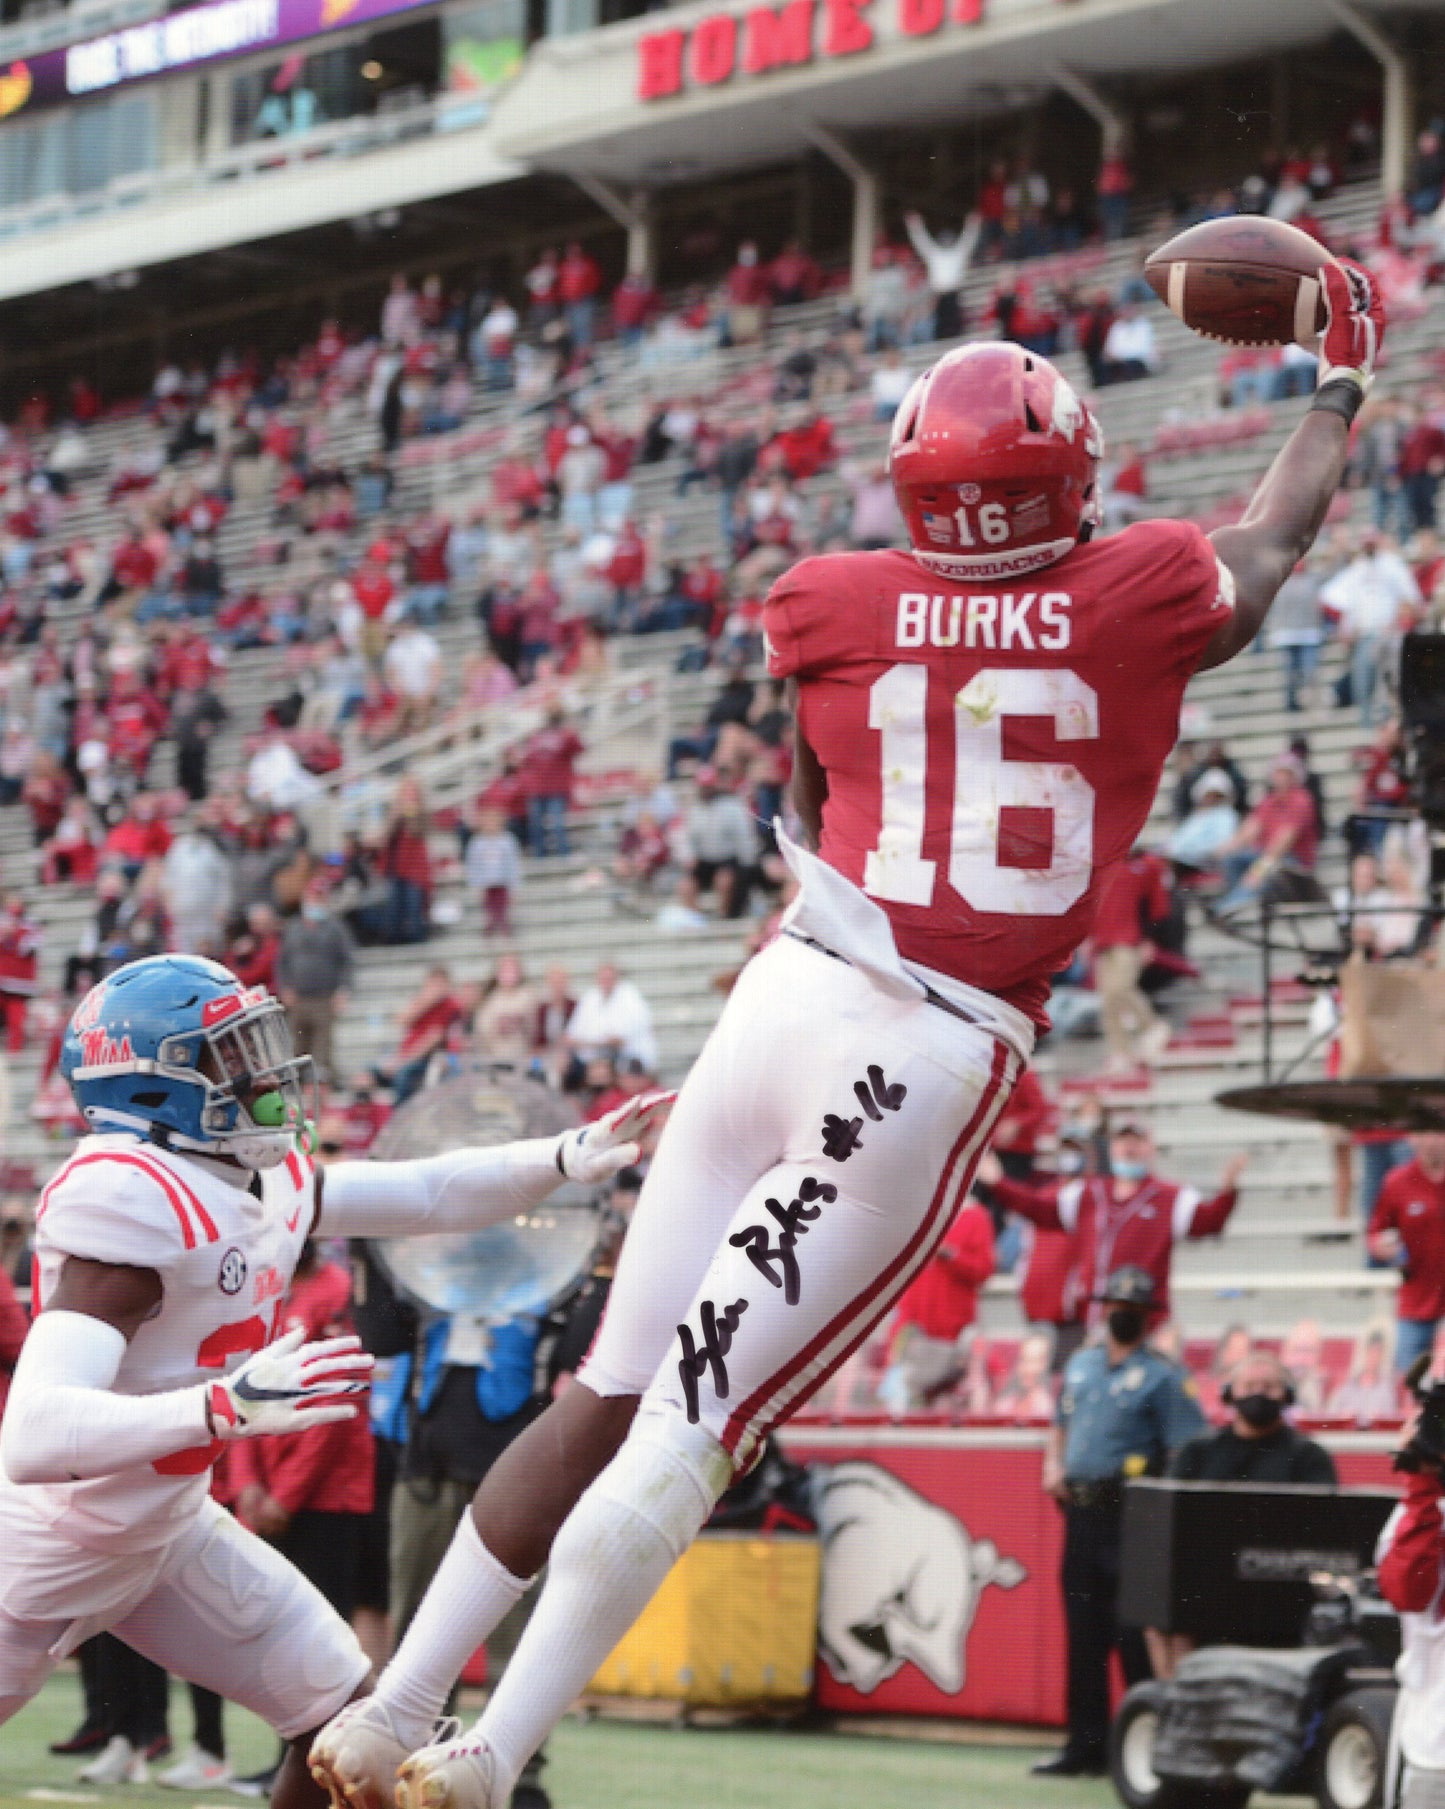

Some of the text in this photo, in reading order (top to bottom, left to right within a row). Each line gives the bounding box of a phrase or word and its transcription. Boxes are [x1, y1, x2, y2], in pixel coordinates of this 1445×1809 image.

[635, 0, 874, 100] HOME
[954, 503, 1010, 546] 16
[895, 592, 1072, 650] BURKS
[862, 663, 1100, 916] 16
